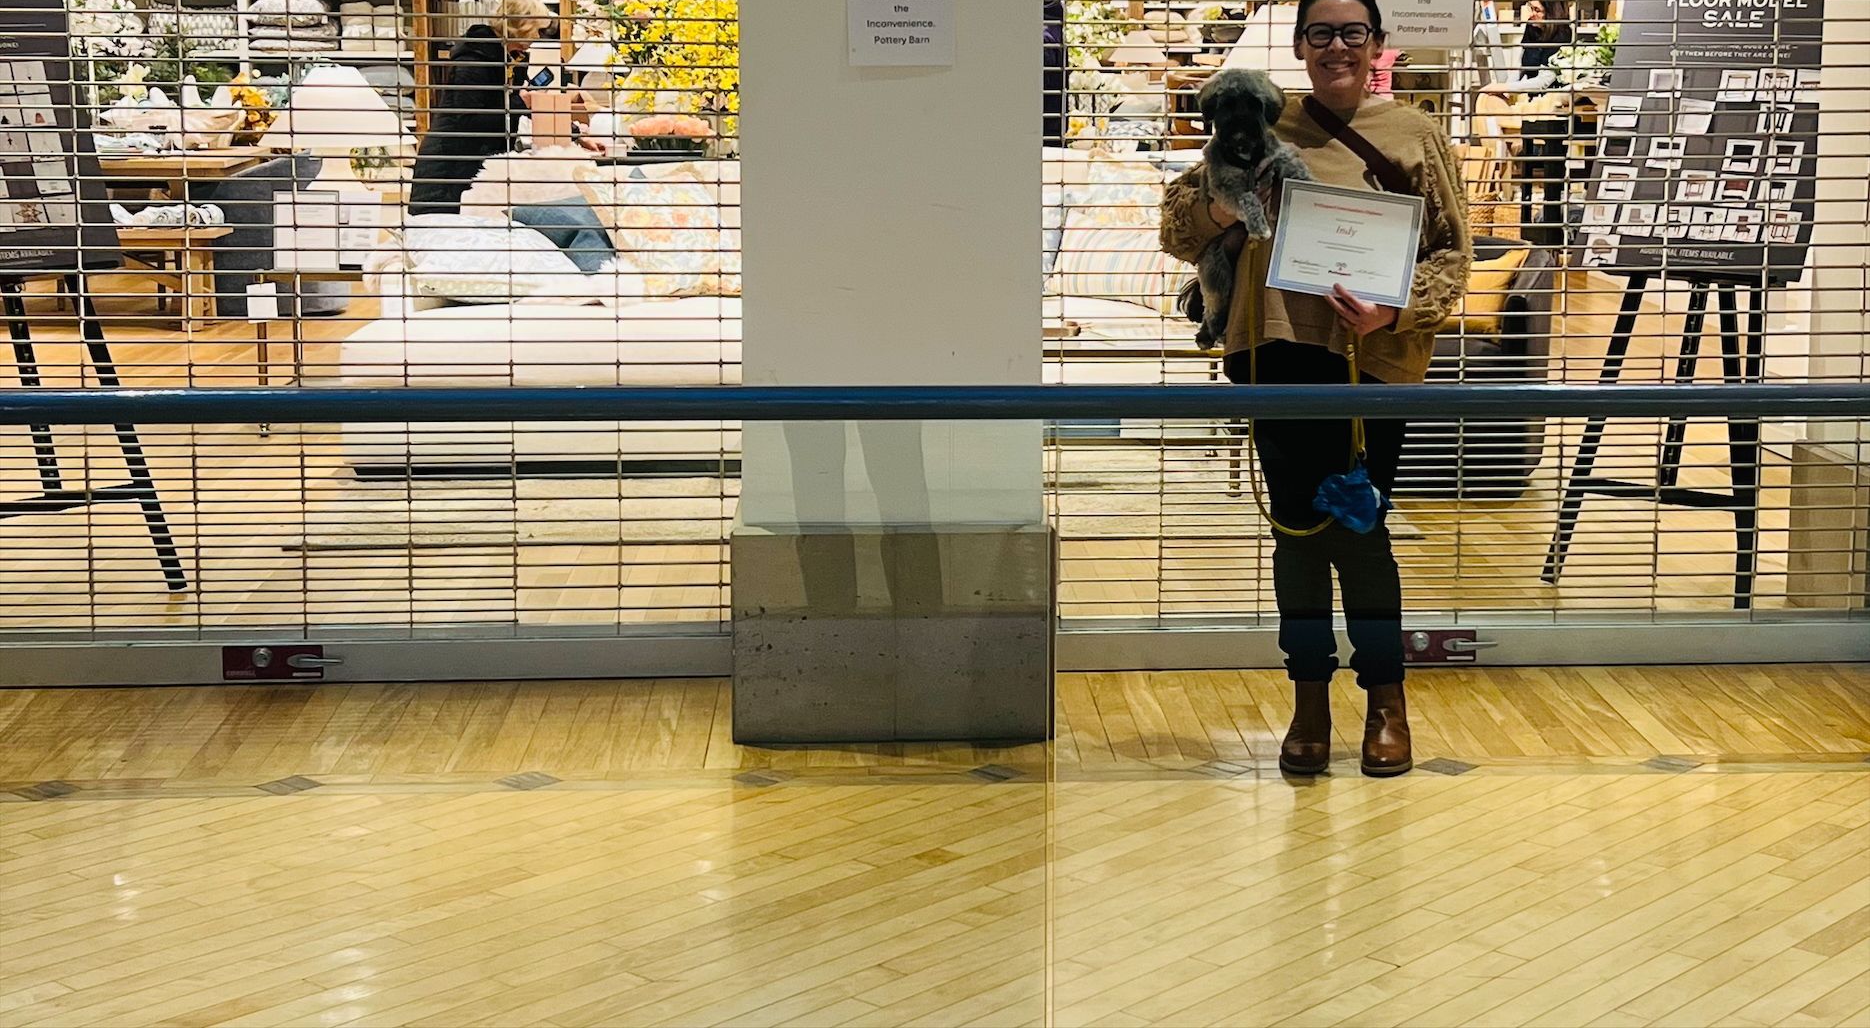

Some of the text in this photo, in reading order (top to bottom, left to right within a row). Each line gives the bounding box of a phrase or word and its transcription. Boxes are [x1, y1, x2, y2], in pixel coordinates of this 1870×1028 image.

[893, 4, 909, 13] the
[1391, 10, 1456, 19] Inconvenience.
[1702, 9, 1765, 28] SALE
[866, 20, 936, 28] Inconvenience.
[1397, 25, 1448, 34] Pottery Barn
[874, 35, 930, 46] Pottery Barn
